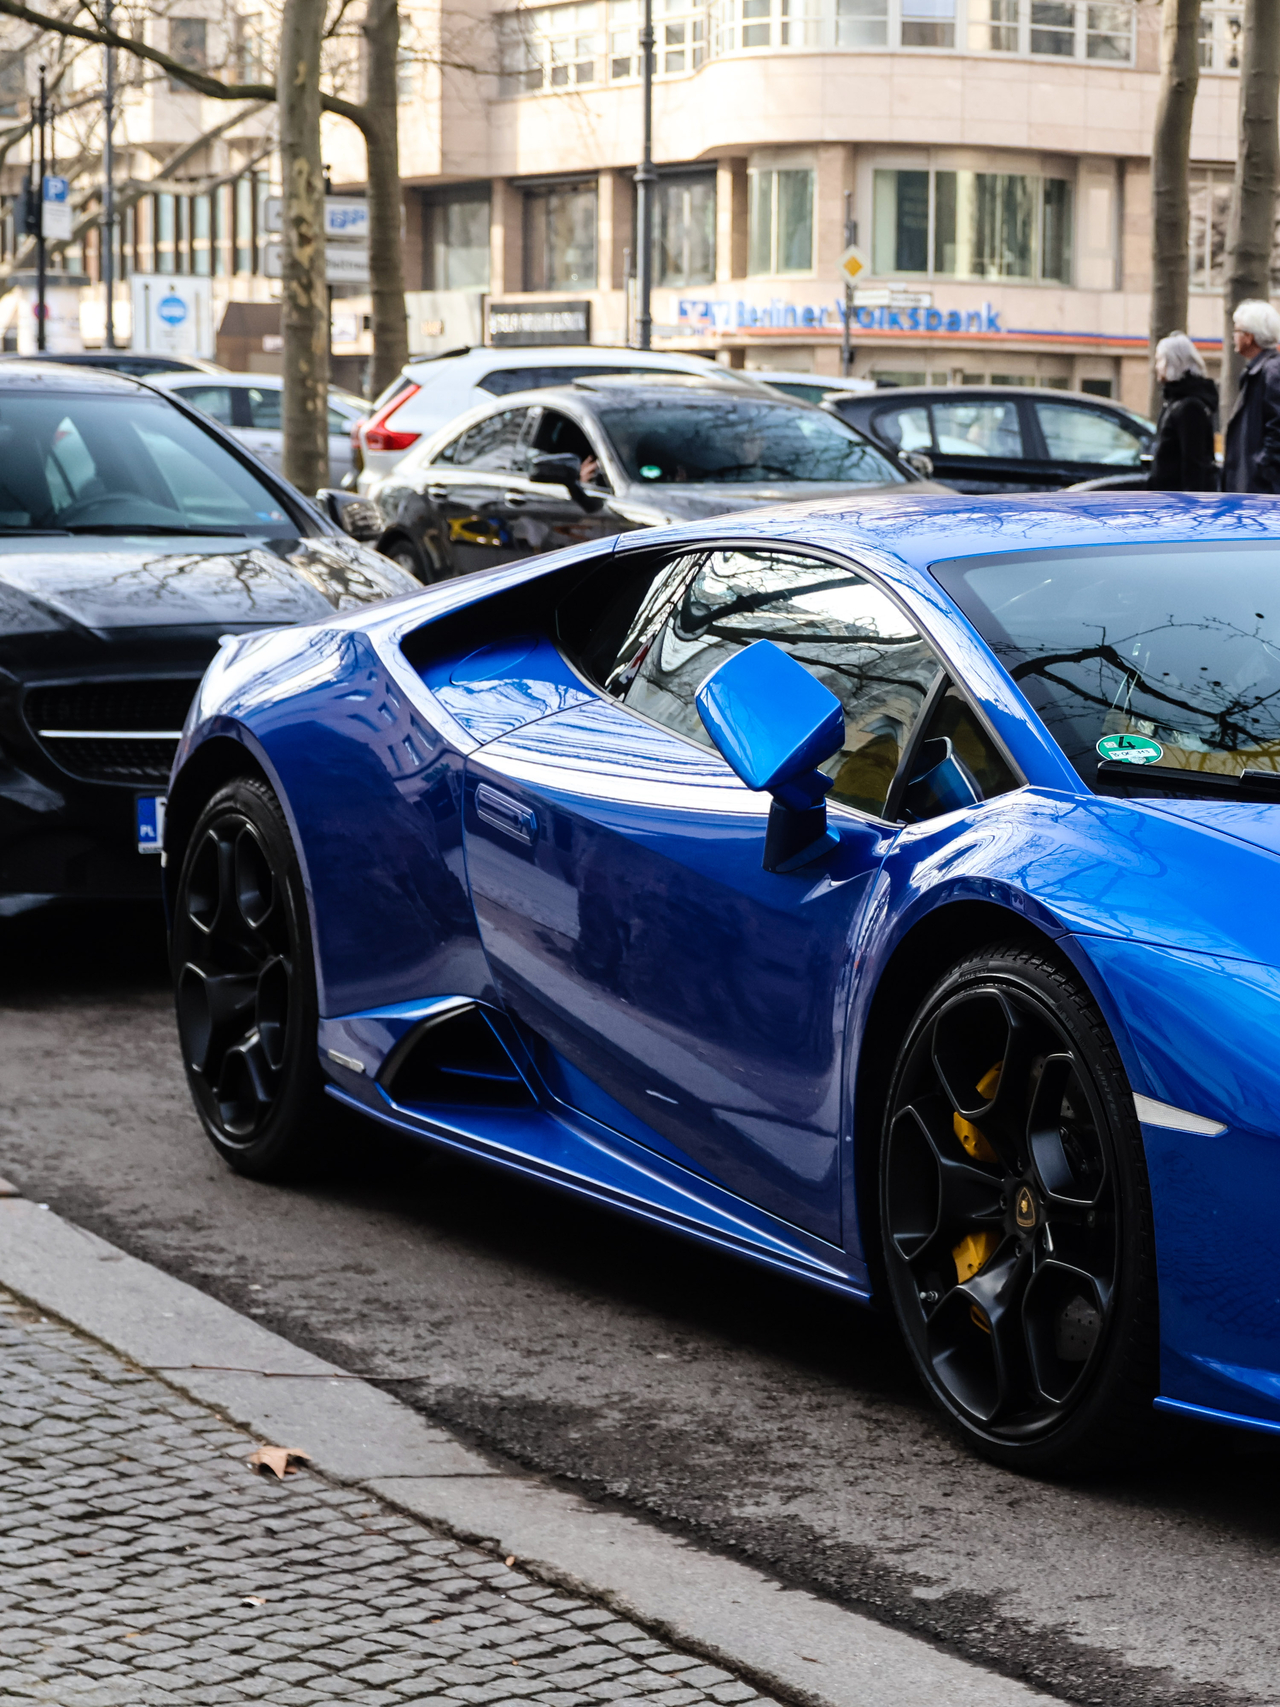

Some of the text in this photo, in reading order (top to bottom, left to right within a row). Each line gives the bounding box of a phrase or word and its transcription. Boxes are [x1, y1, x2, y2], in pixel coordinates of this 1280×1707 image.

[48, 180, 64, 201] P
[737, 298, 829, 328] Berliner
[1118, 737, 1136, 749] 4
[140, 824, 156, 837] PL
